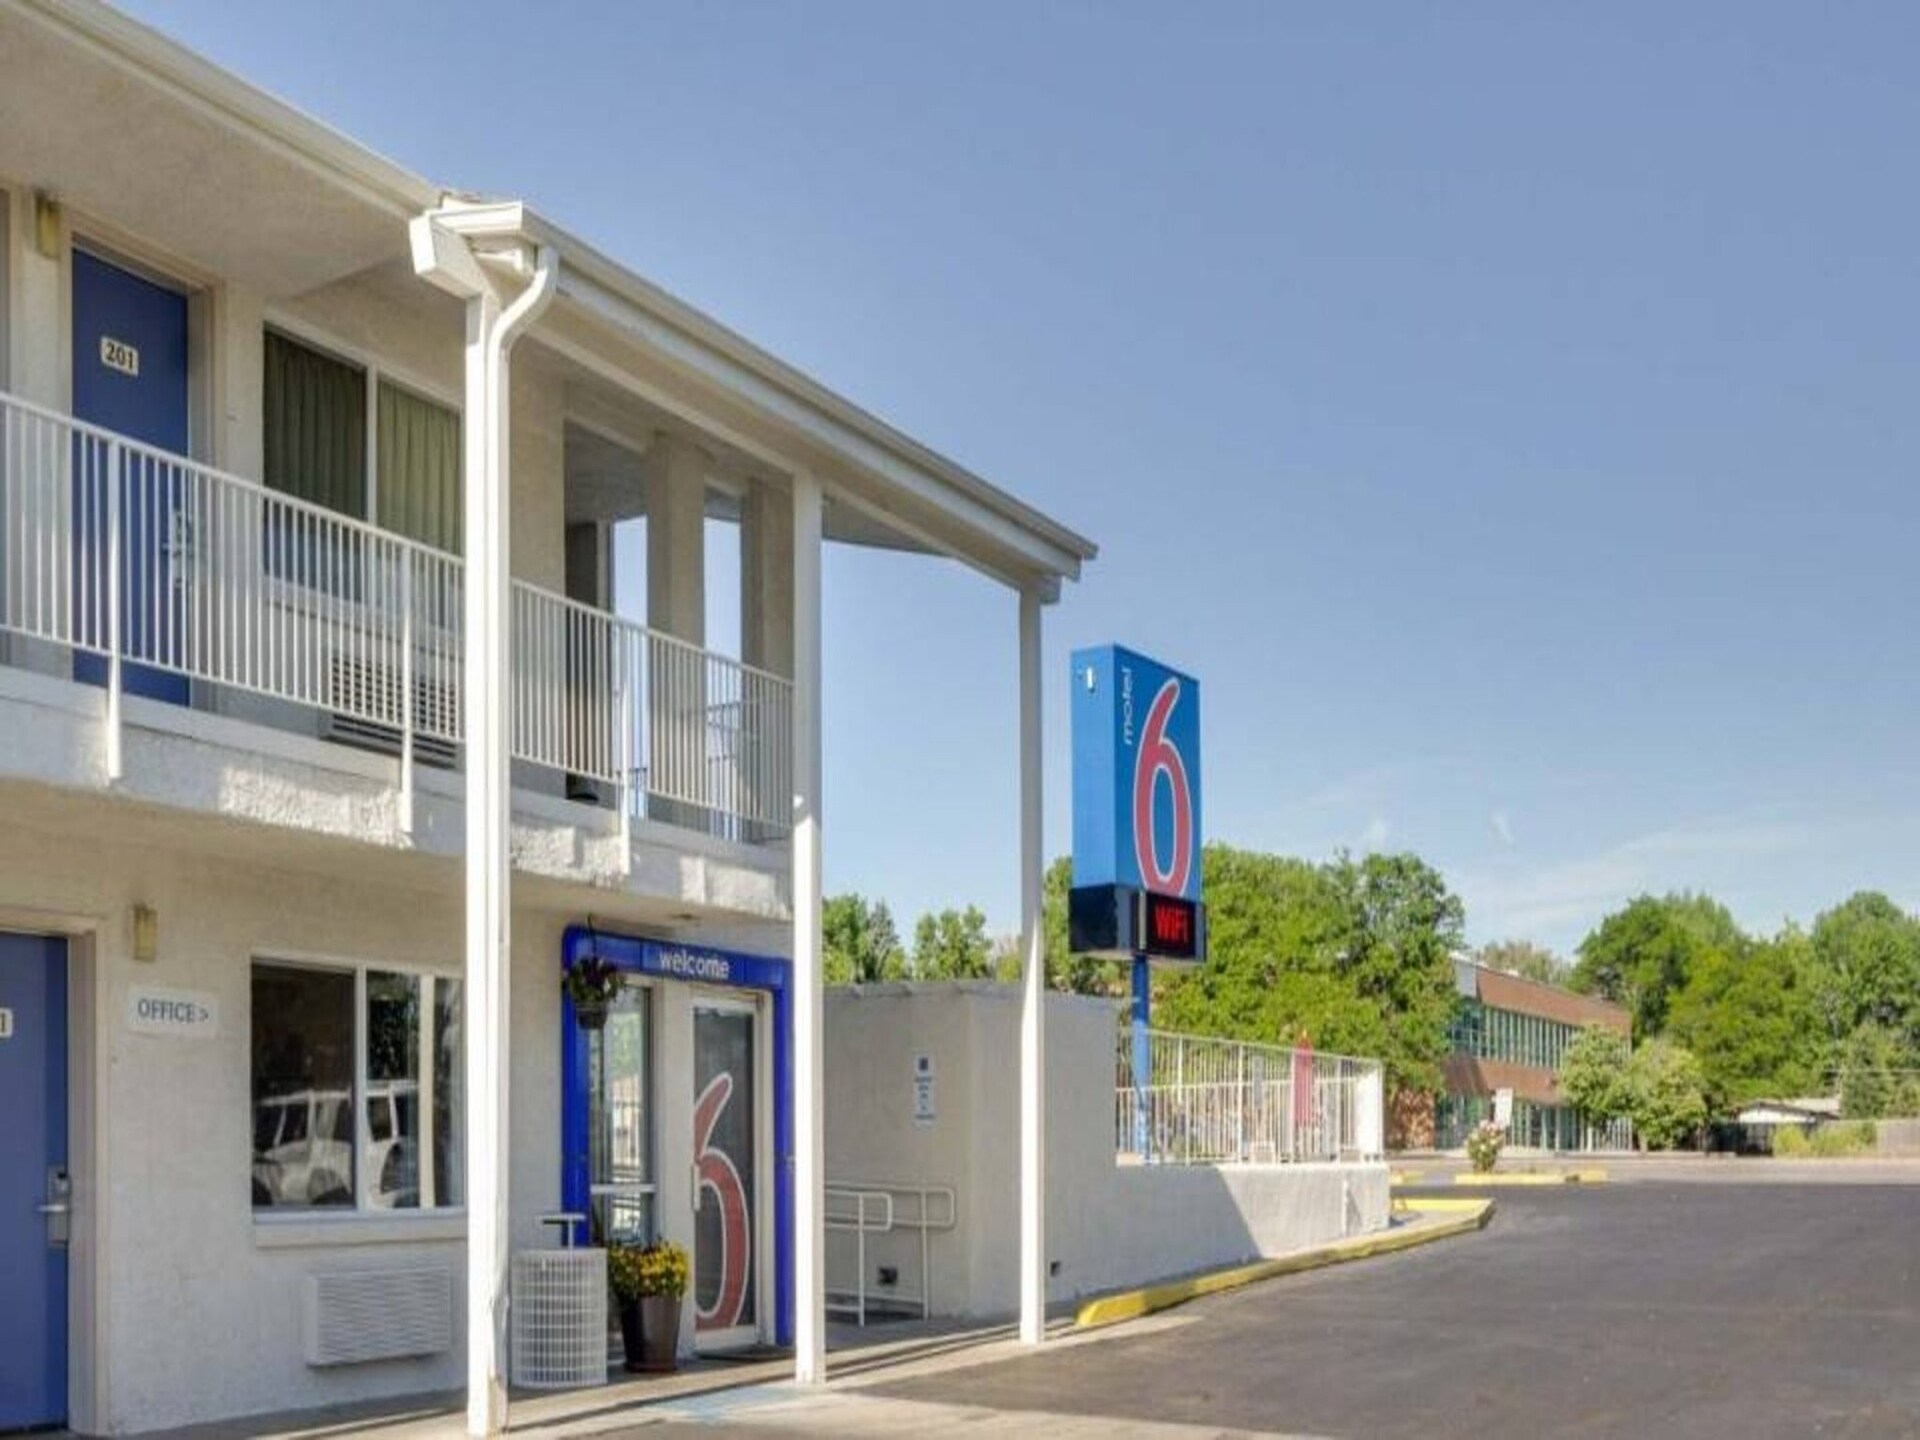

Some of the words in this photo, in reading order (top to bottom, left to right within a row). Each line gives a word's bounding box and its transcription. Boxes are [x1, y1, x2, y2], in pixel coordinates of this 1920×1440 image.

[106, 341, 133, 370] 201
[1122, 665, 1133, 745] motel
[1134, 677, 1193, 898] 6
[660, 948, 730, 980] welcome
